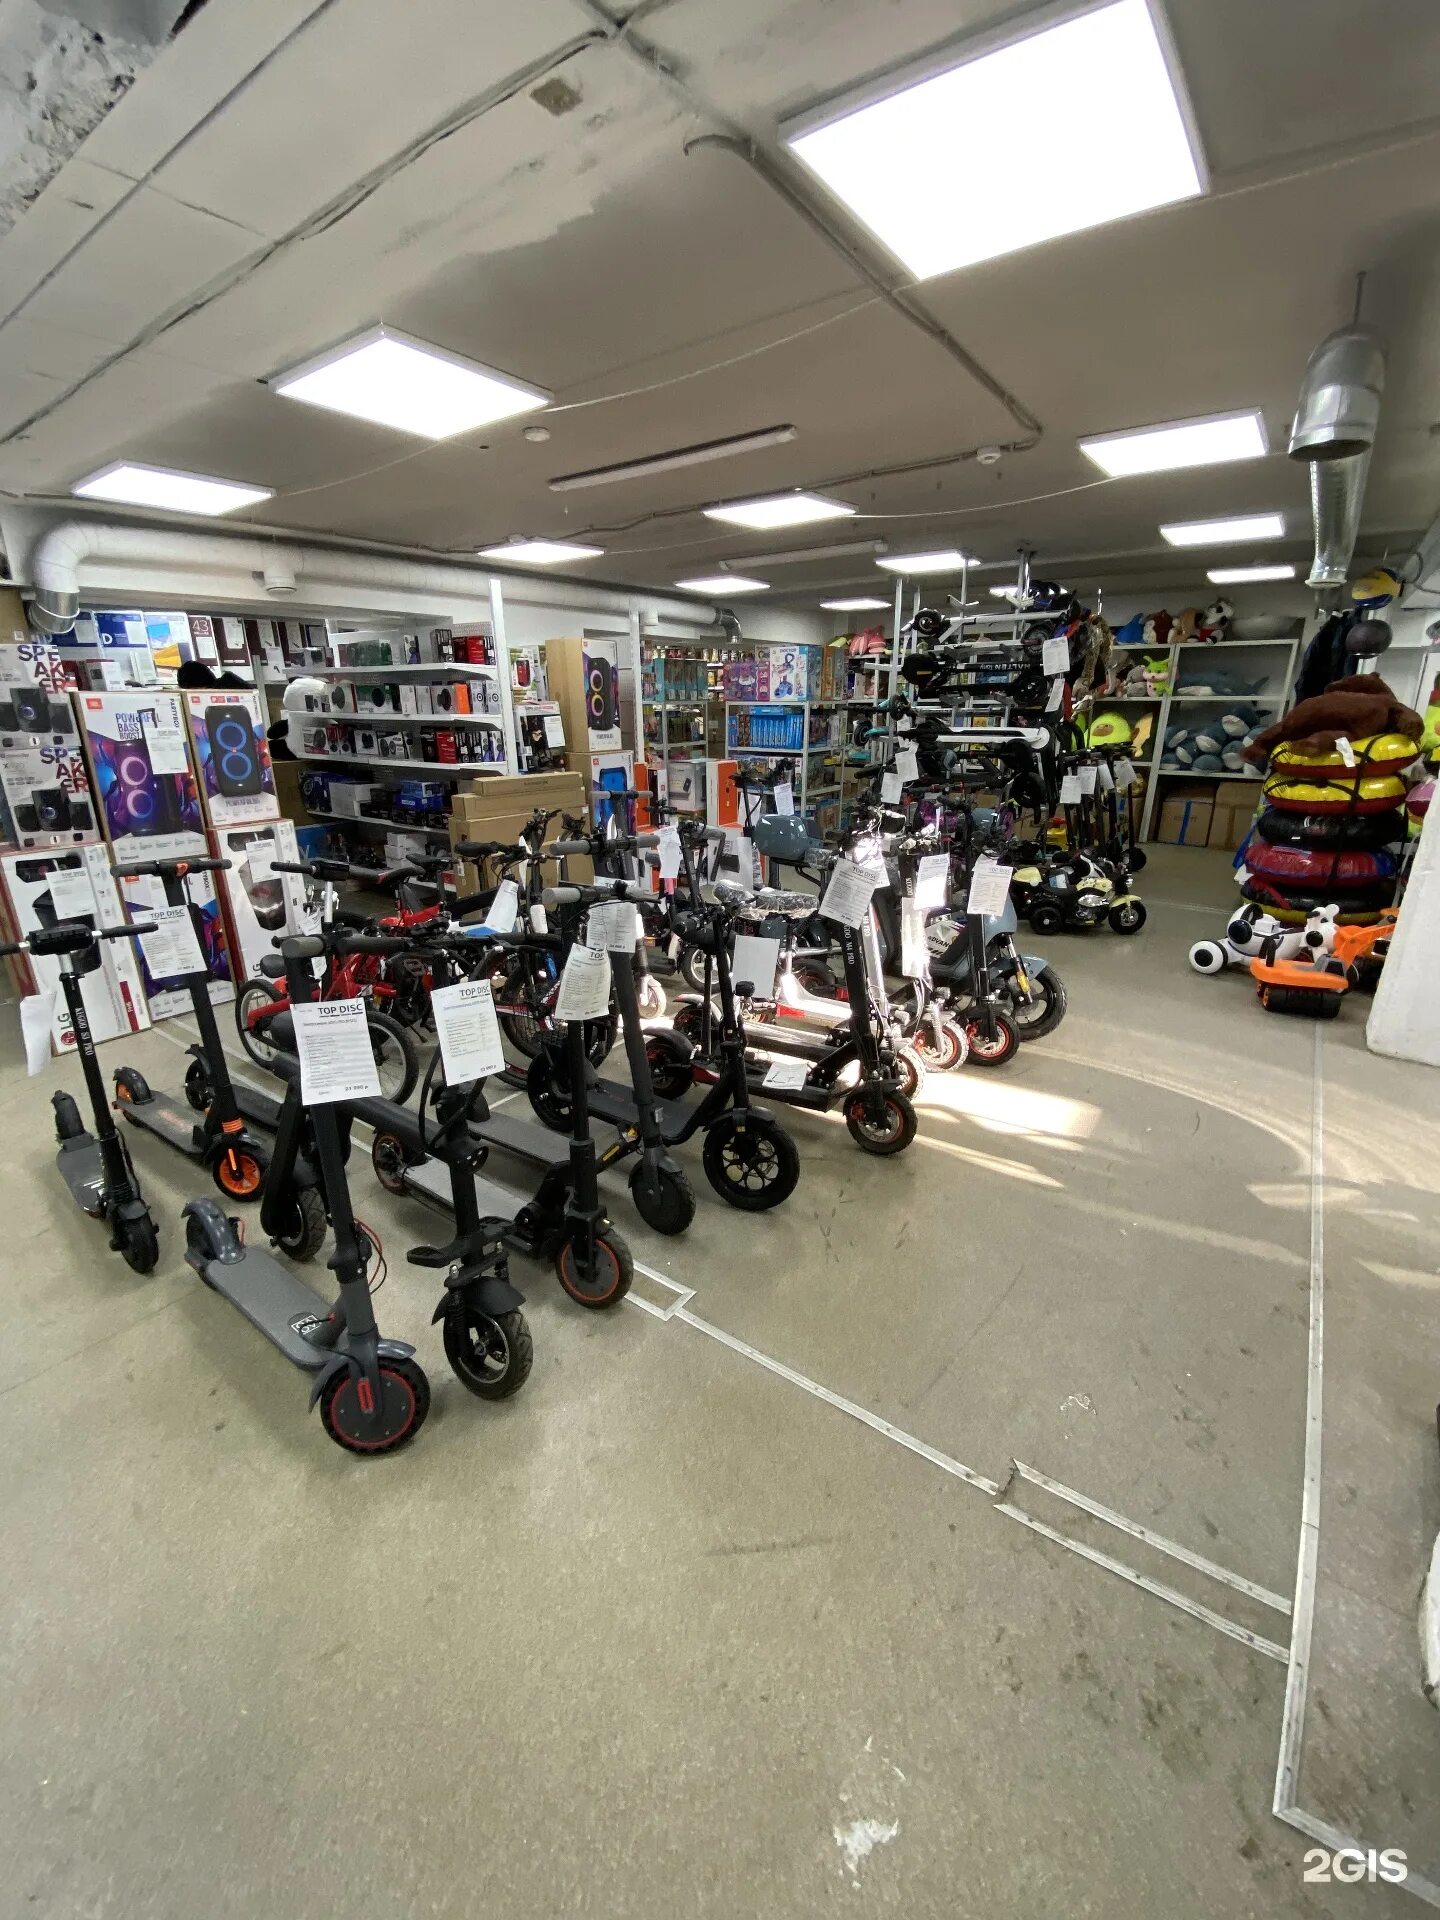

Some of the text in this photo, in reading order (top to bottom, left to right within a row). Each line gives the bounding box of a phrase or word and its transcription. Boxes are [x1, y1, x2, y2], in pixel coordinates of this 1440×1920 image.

[192, 619, 209, 632] 43
[34, 661, 66, 678] AK
[115, 711, 162, 723] POWERFL
[117, 723, 140, 733] BASS
[55, 763, 86, 780] AK
[150, 908, 185, 920] TOP DISC
[927, 936, 952, 948] ADVAN
[252, 963, 262, 978] LG
[459, 985, 490, 998] TOP DISC
[318, 1003, 364, 1016] TOP DISC
[57, 1012, 73, 1030] LG
